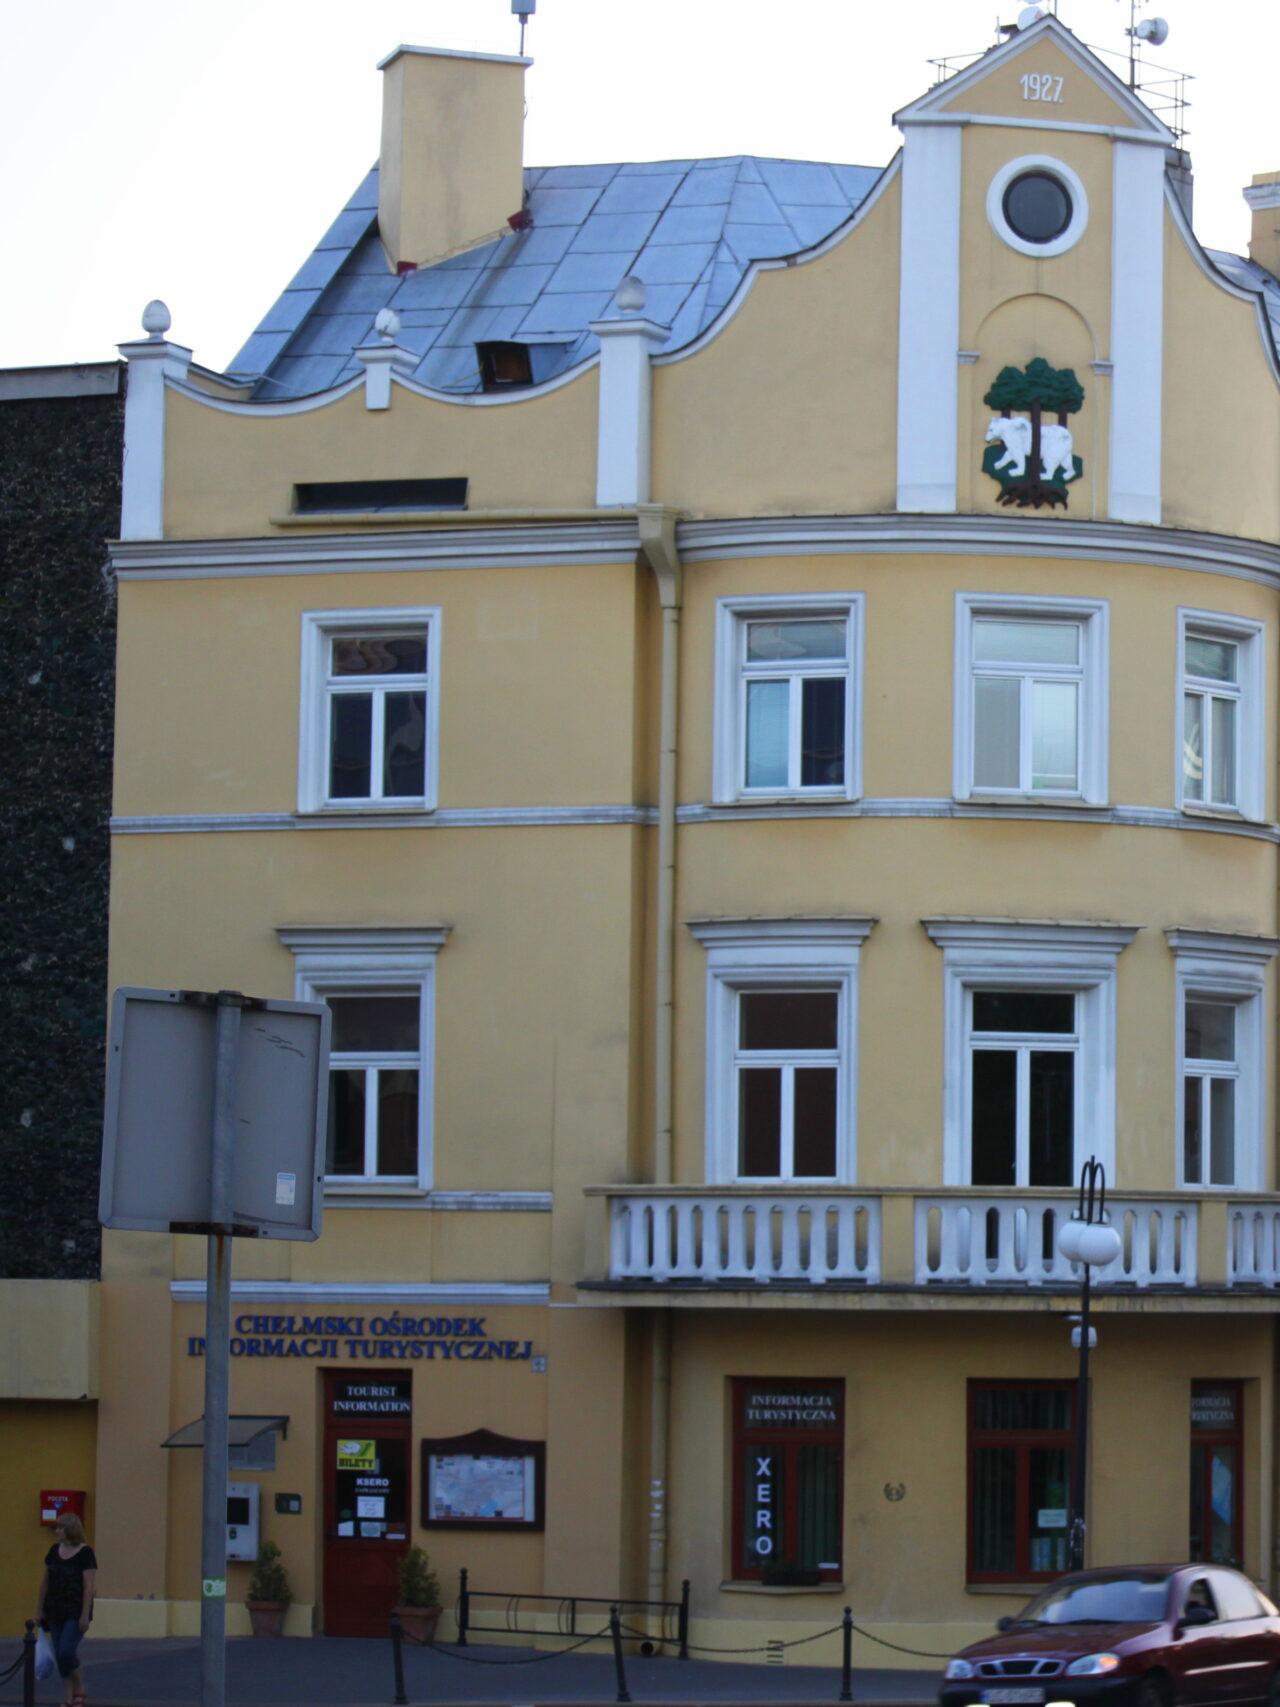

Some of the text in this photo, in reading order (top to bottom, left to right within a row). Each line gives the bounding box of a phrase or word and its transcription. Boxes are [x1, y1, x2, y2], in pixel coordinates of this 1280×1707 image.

[235, 1310, 487, 1337] CHEŁMSKI OŚRODEK
[187, 1337, 533, 1361] INORMACJI TURYSTYCZNEJ
[346, 1385, 398, 1397] TOURIST
[333, 1400, 411, 1412] INFORMATION
[751, 1395, 833, 1406] INFORMACJA
[746, 1409, 837, 1420] TURYSTYCZNA
[356, 1477, 390, 1487] KSERO
[755, 1456, 773, 1555] XERO
